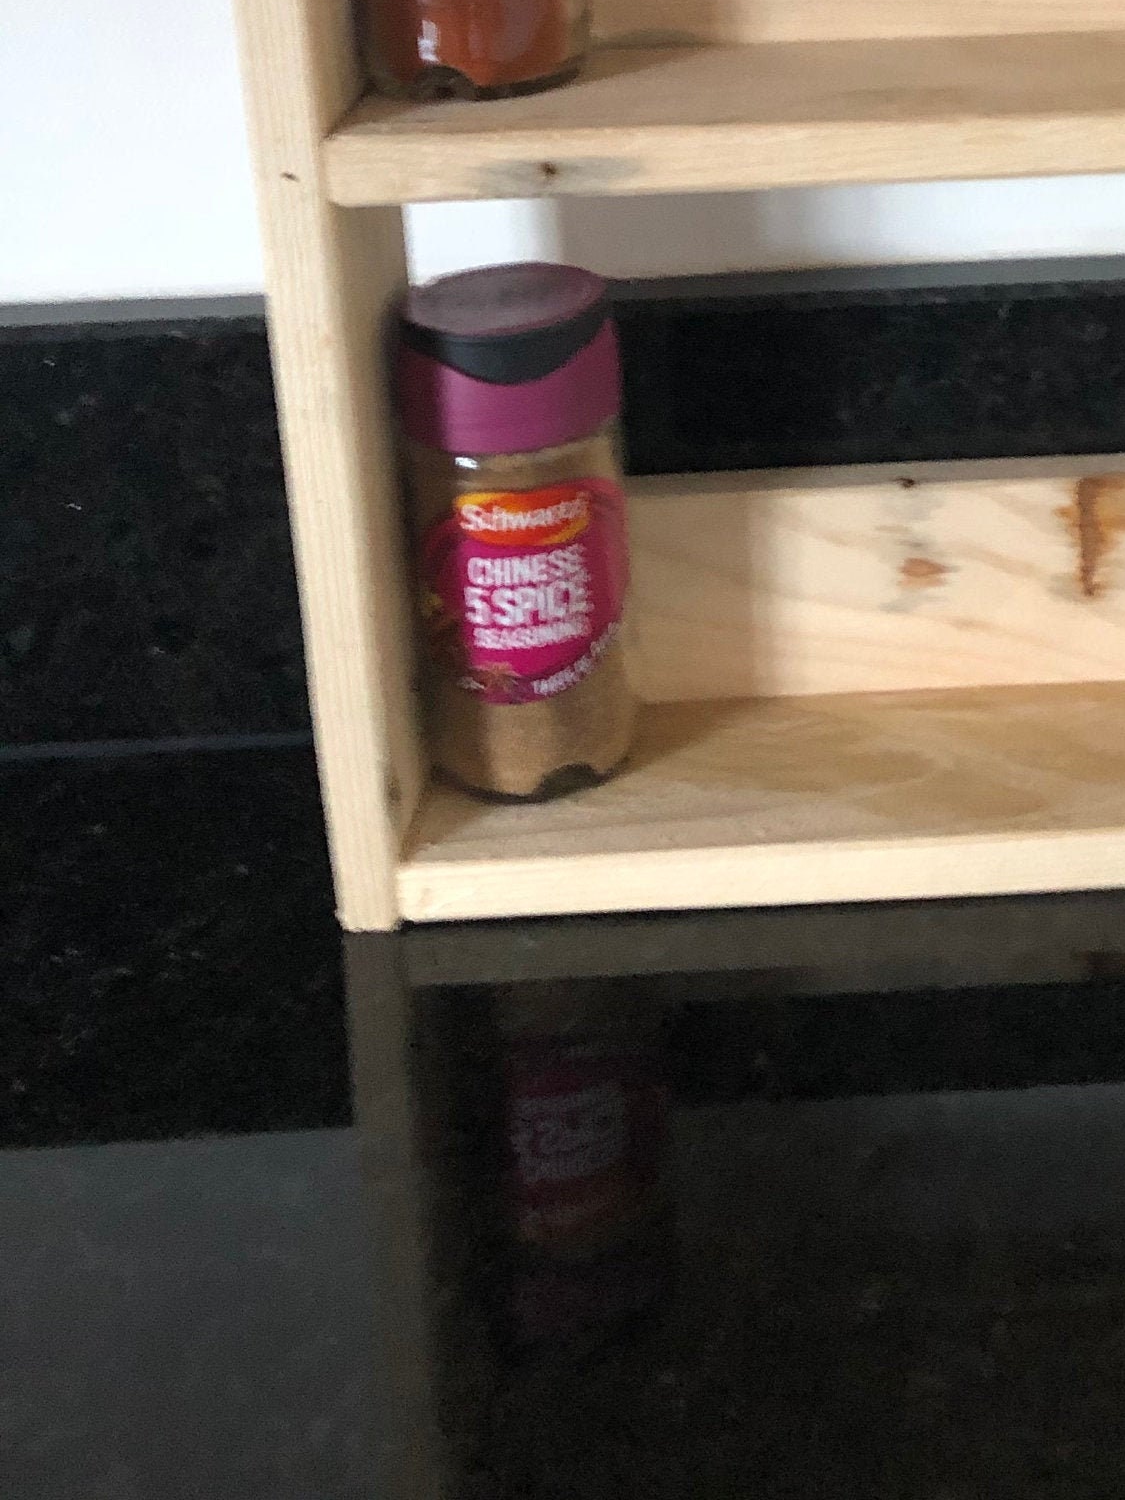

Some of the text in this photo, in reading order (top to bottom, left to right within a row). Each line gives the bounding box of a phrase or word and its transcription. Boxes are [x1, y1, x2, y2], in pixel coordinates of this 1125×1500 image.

[467, 545, 588, 586] CHINESE
[464, 579, 594, 627] 5 SPICE
